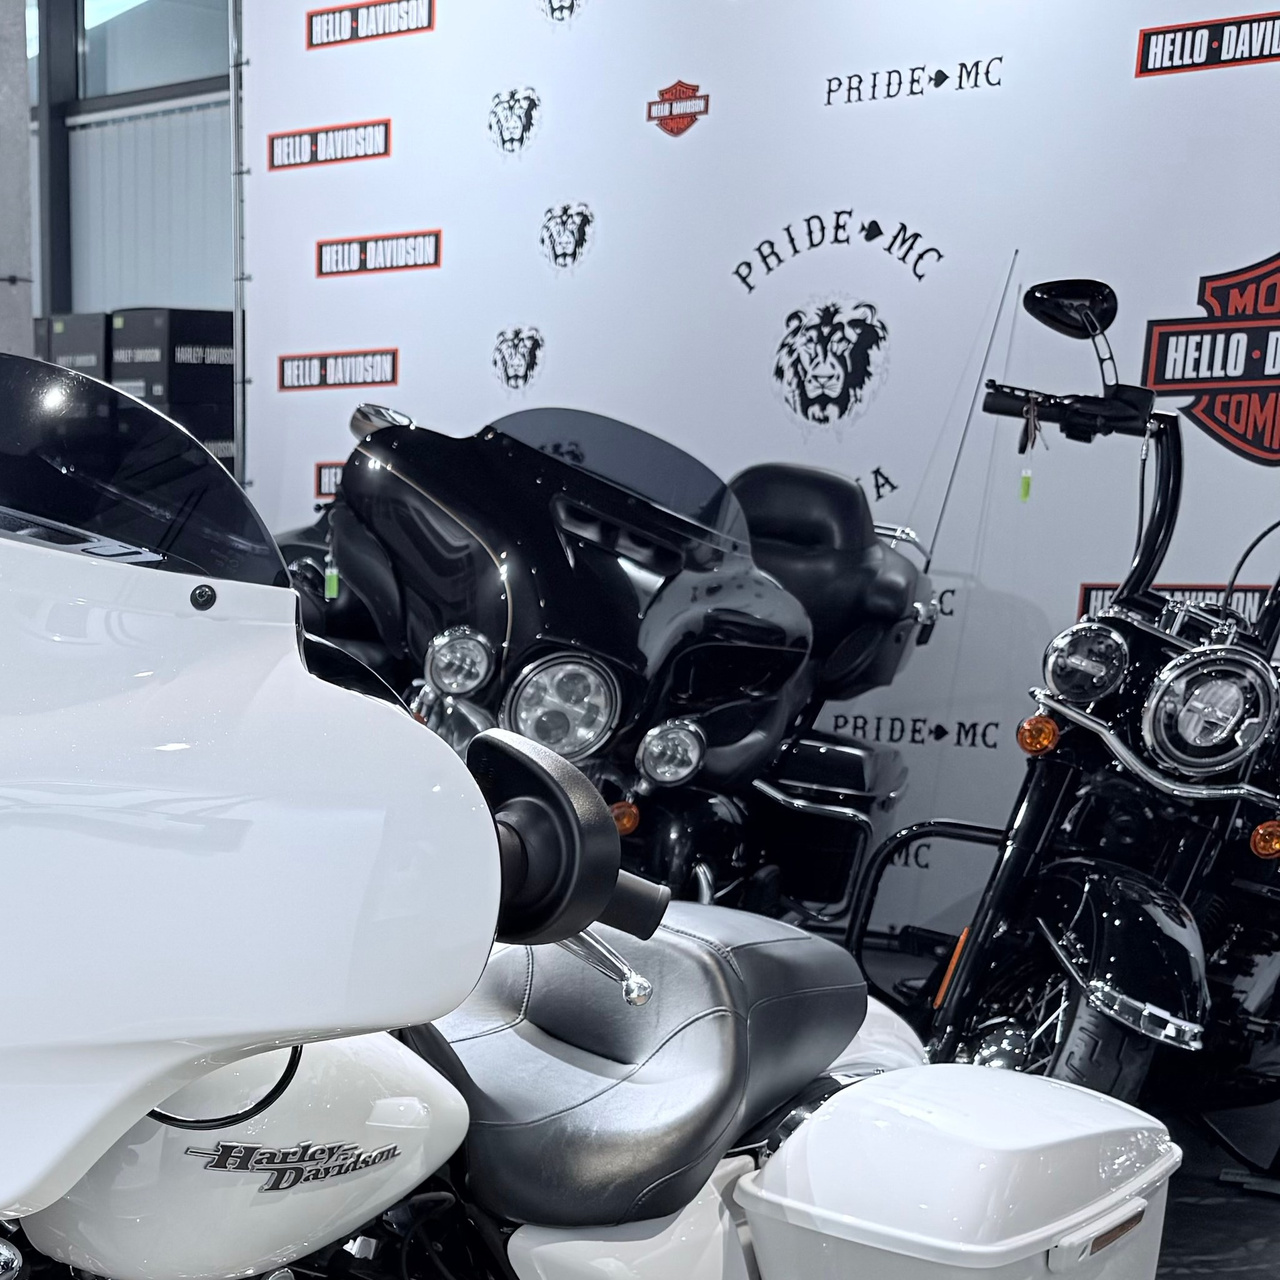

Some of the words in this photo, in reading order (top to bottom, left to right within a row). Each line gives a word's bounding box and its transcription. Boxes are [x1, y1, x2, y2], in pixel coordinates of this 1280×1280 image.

[312, 10, 352, 45] HELLO
[357, 0, 429, 38] DAVIDSON
[1147, 28, 1209, 69] HELLO
[824, 64, 926, 106] PRIDE
[955, 56, 1003, 90] MC
[273, 134, 312, 166] HELLO
[317, 124, 386, 161] DAVIDSON
[321, 242, 361, 273] HELLO
[366, 235, 436, 269] DAVIDSON
[732, 208, 854, 294] PRIDE
[883, 221, 944, 282] MC
[283, 358, 321, 387] HELLO
[326, 352, 393, 385] DAVIDSON
[1164, 332, 1248, 380] HELLO
[833, 714, 927, 744] PRIDE
[954, 721, 1000, 749] MC
[258, 1143, 402, 1193] Davidson
